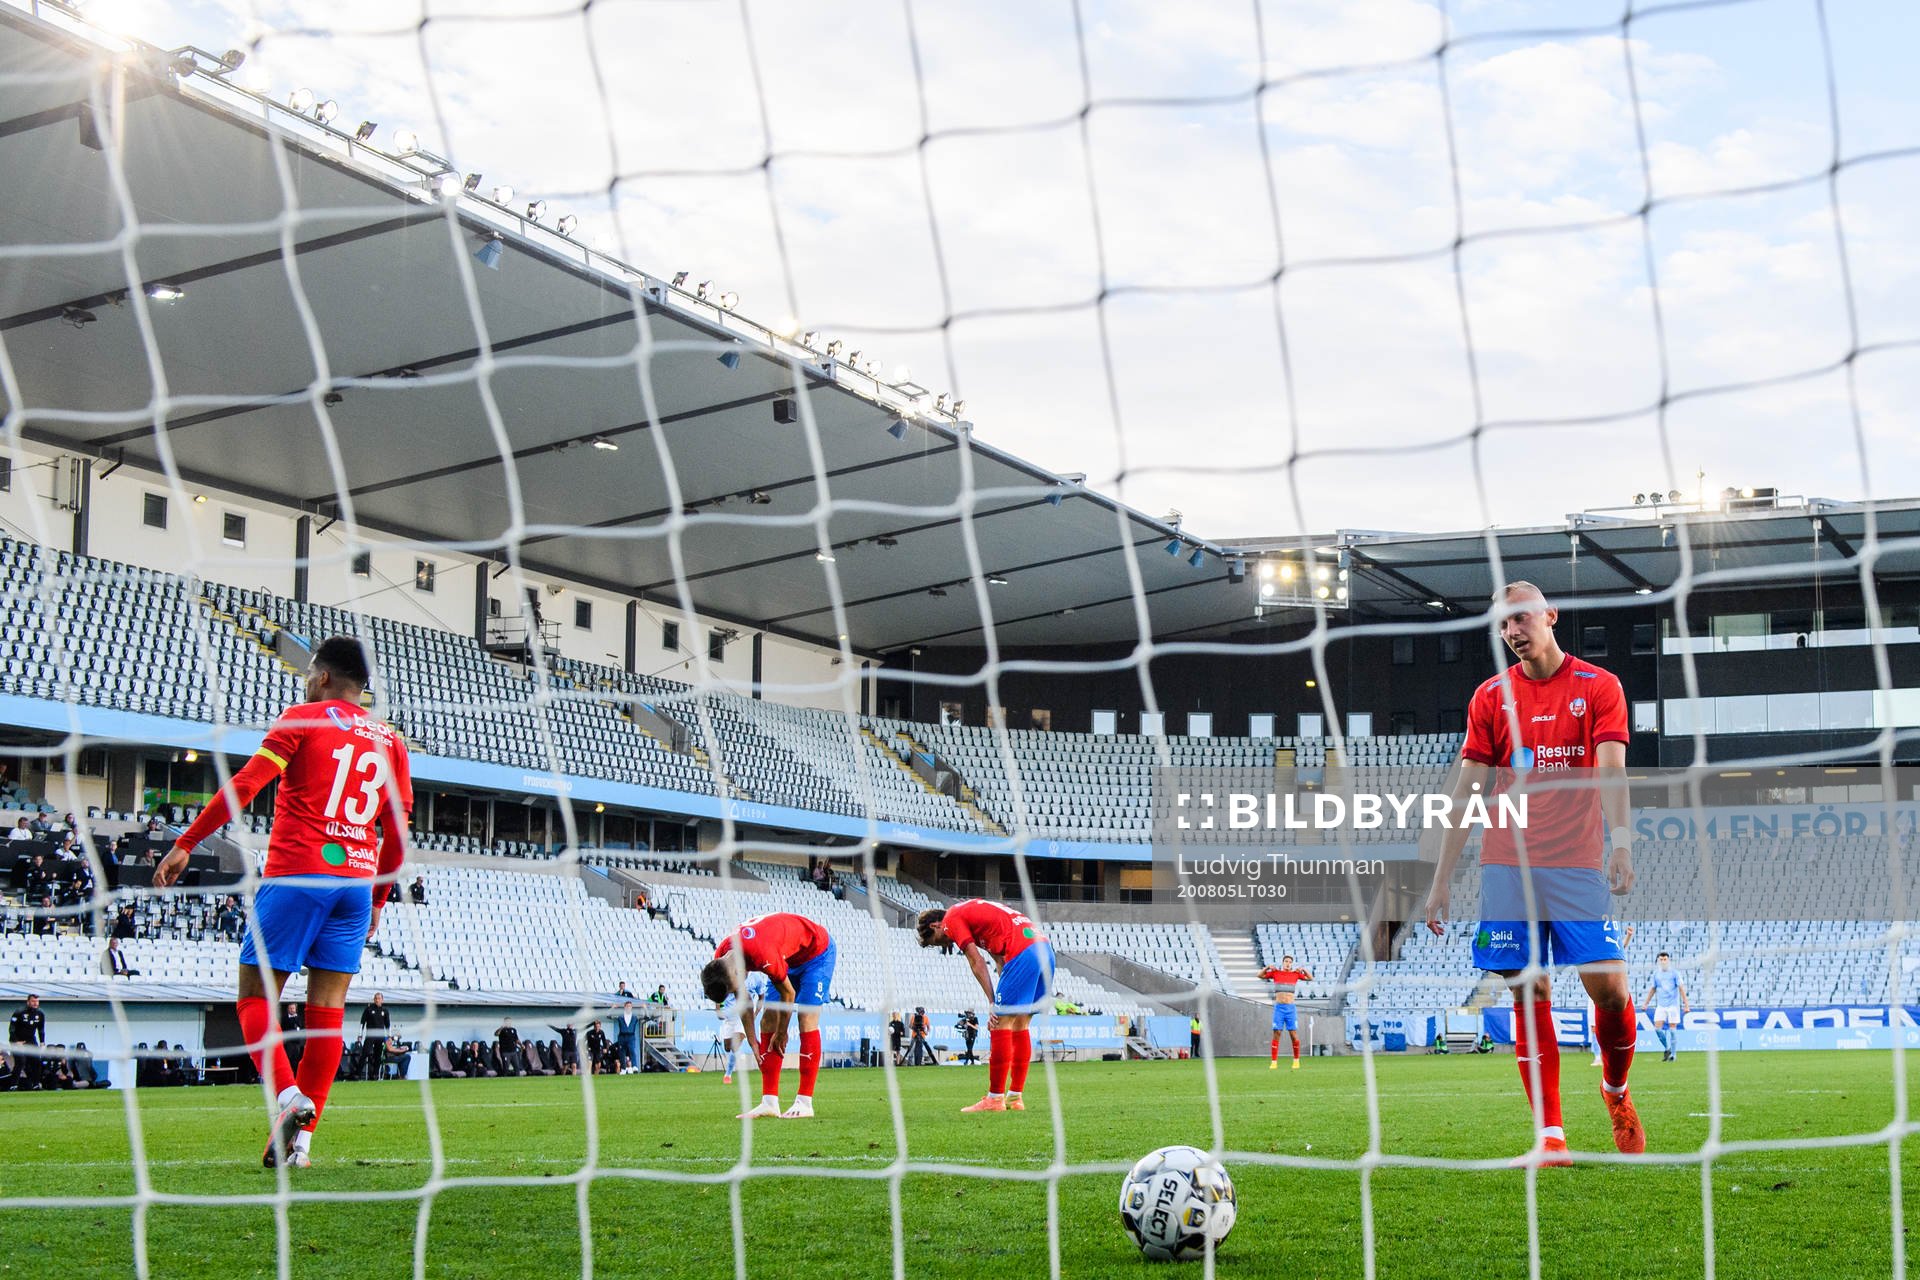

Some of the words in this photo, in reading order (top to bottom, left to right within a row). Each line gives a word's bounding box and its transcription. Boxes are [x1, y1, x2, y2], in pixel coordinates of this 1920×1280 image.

[354, 728, 393, 747] diabetes
[1537, 745, 1585, 759] Resurs
[1537, 758, 1572, 774] Bank
[324, 743, 388, 825] 13
[1792, 805, 1868, 837] FÖR
[346, 845, 375, 862] Solid
[1491, 930, 1513, 941] Solid
[1149, 1178, 1178, 1241] SELECT
